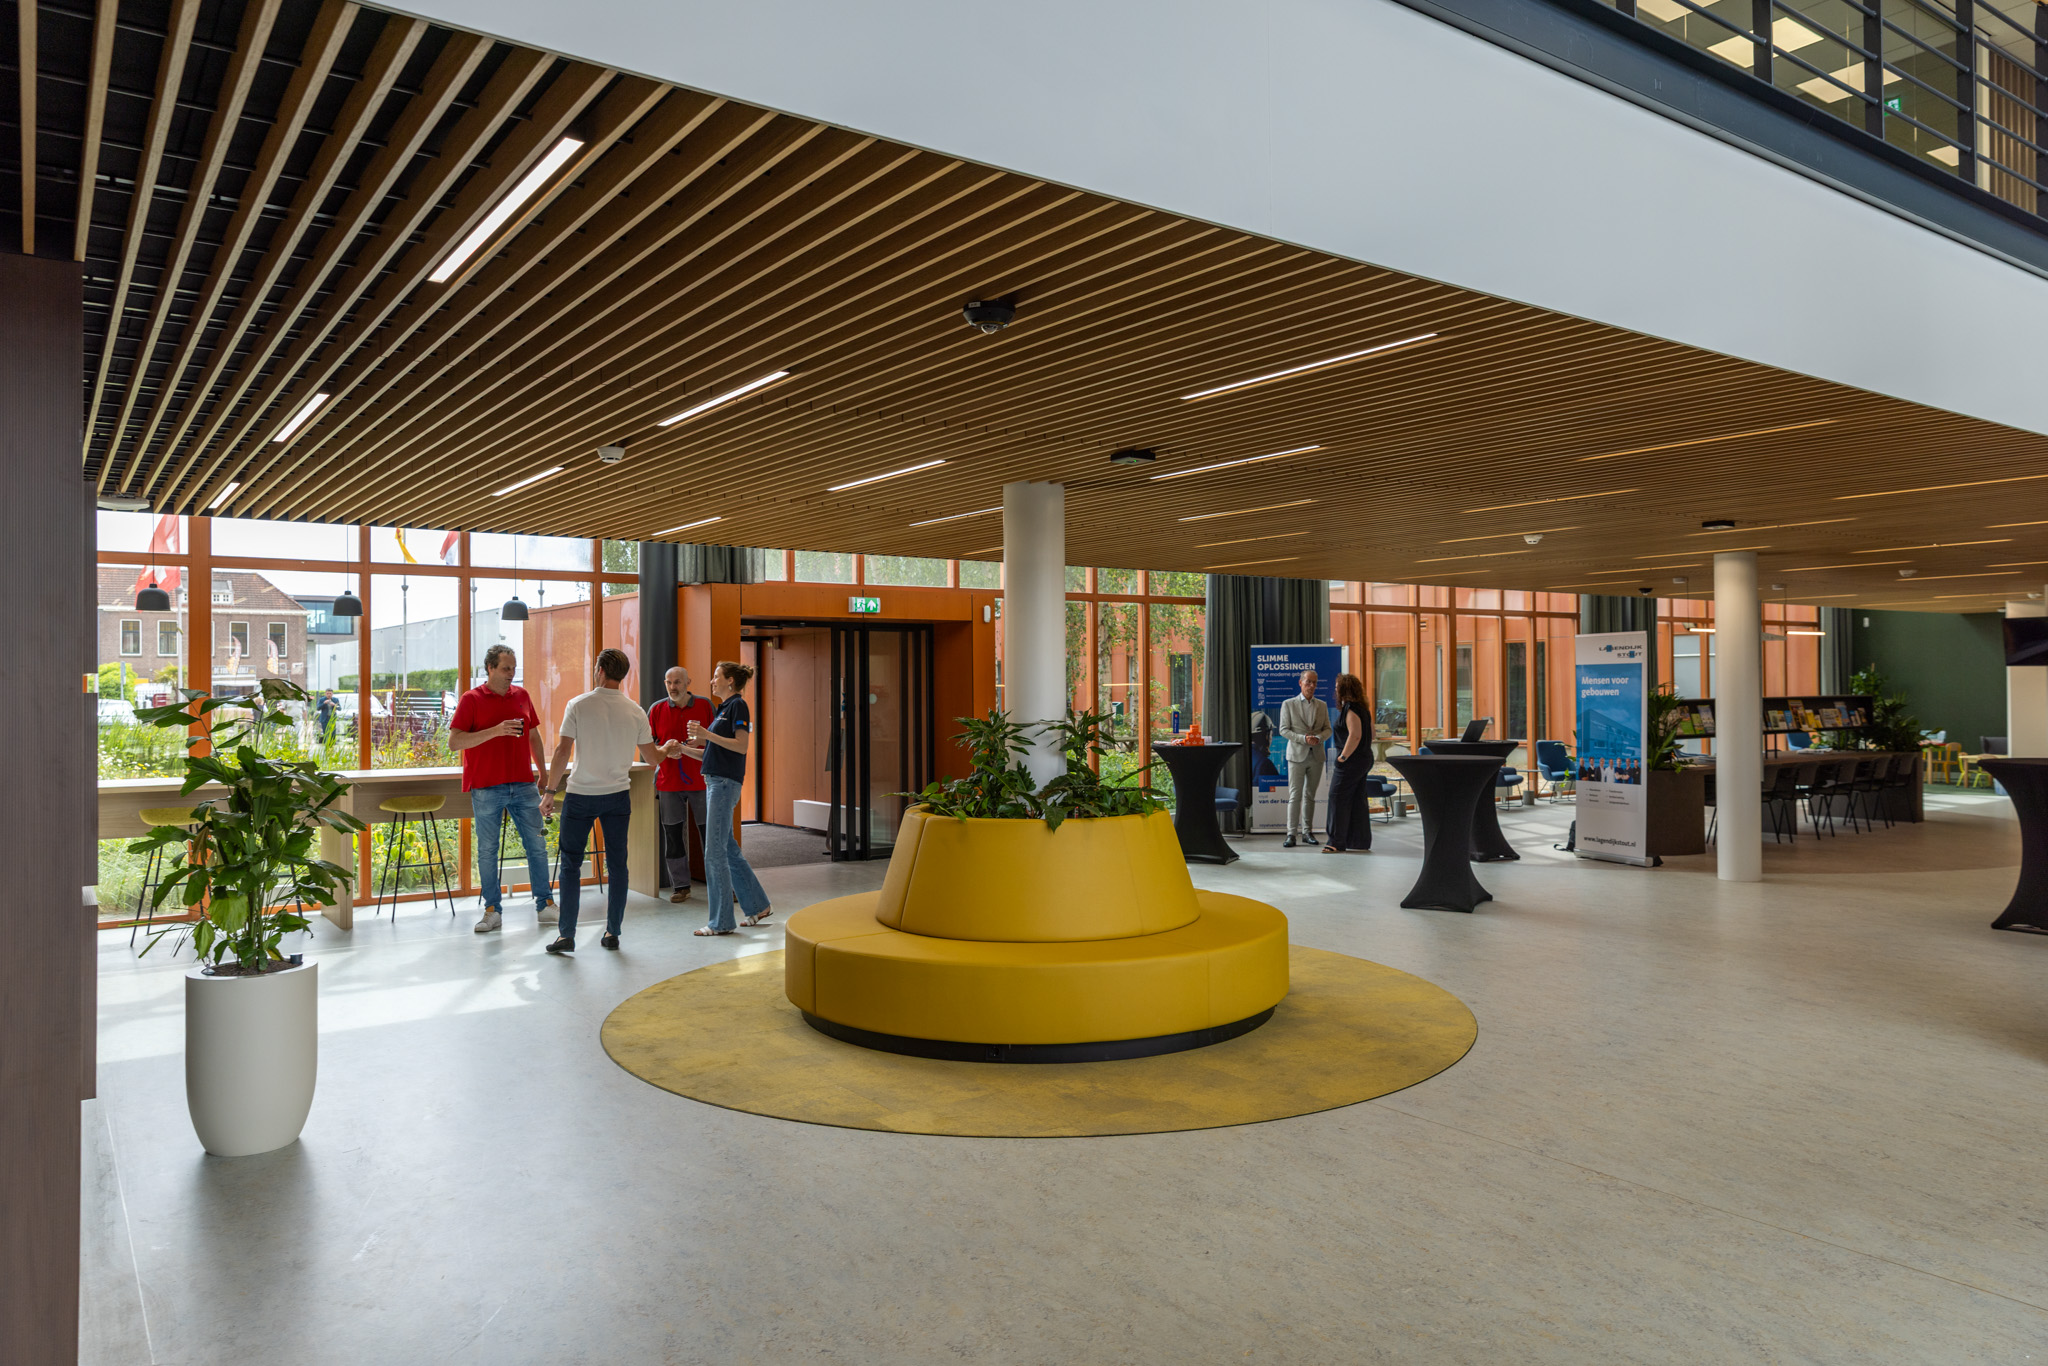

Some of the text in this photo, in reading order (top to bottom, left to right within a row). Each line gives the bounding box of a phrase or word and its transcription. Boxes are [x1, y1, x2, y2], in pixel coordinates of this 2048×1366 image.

[1257, 654, 1289, 662] SLIMME
[1257, 663, 1316, 671] OPLOSSINGEN
[1581, 676, 1629, 685] Mensen voor
[1581, 687, 1620, 699] gebouwen
